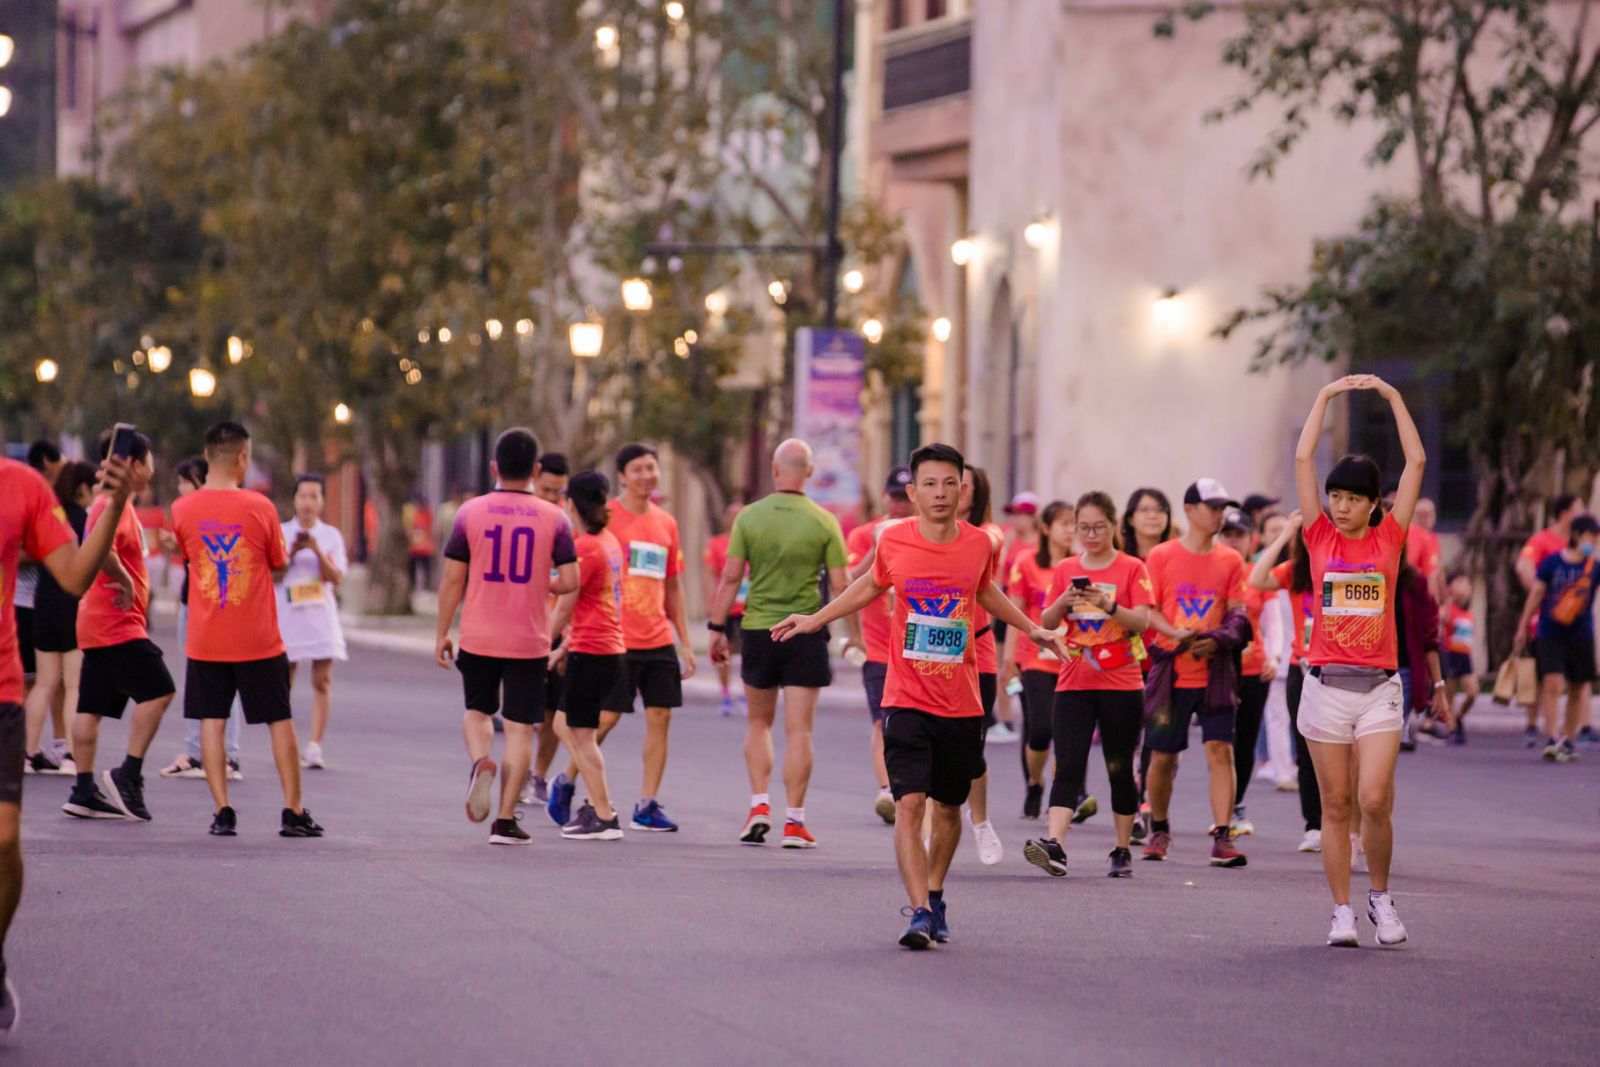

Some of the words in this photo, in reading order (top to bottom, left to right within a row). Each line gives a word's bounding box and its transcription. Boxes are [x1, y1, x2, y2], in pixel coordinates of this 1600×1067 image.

[483, 525, 535, 584] 10
[1345, 584, 1379, 601] 6685
[928, 629, 963, 647] 5938
